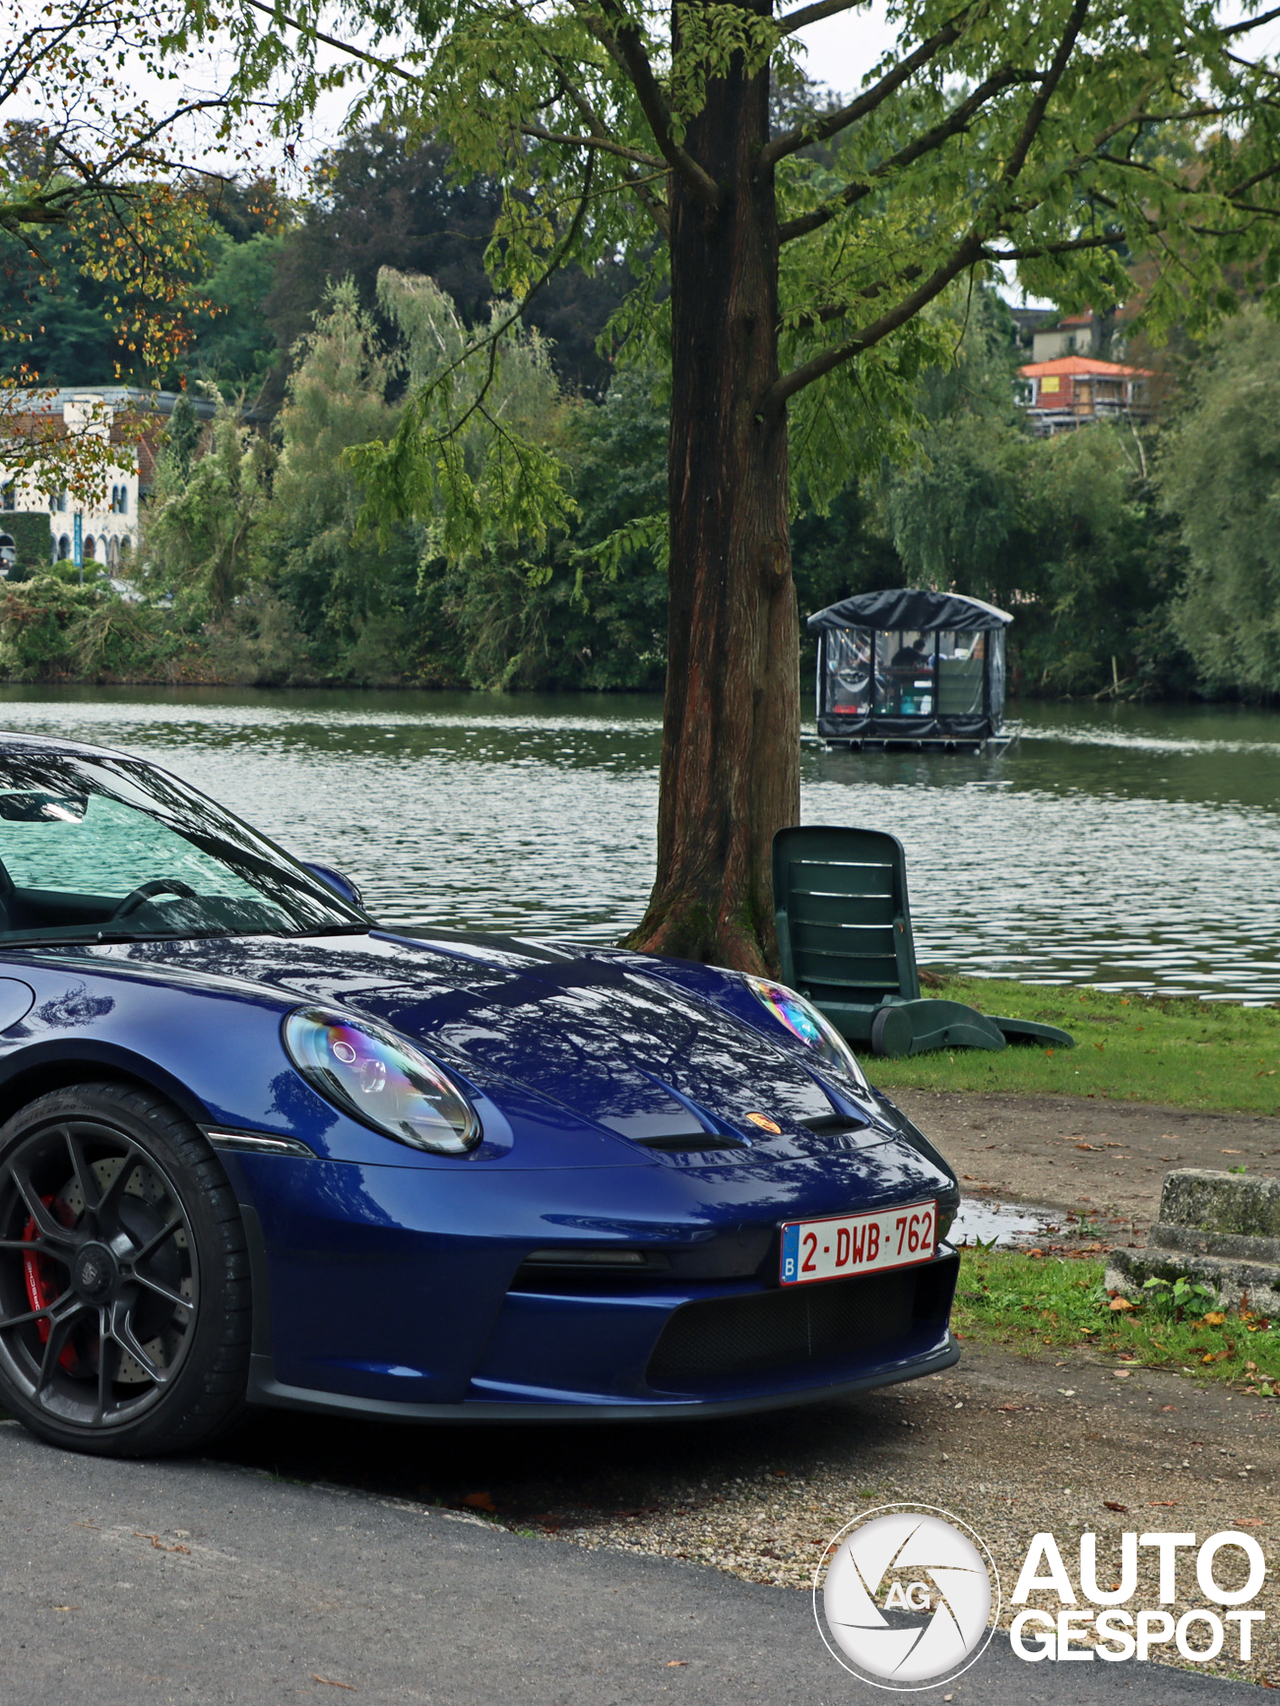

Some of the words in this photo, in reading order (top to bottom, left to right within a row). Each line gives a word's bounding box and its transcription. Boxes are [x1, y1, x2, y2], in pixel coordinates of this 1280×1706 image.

[785, 1257, 795, 1276] B
[801, 1211, 933, 1272] 2-DWB-762
[27, 1261, 41, 1314] ORSCHE
